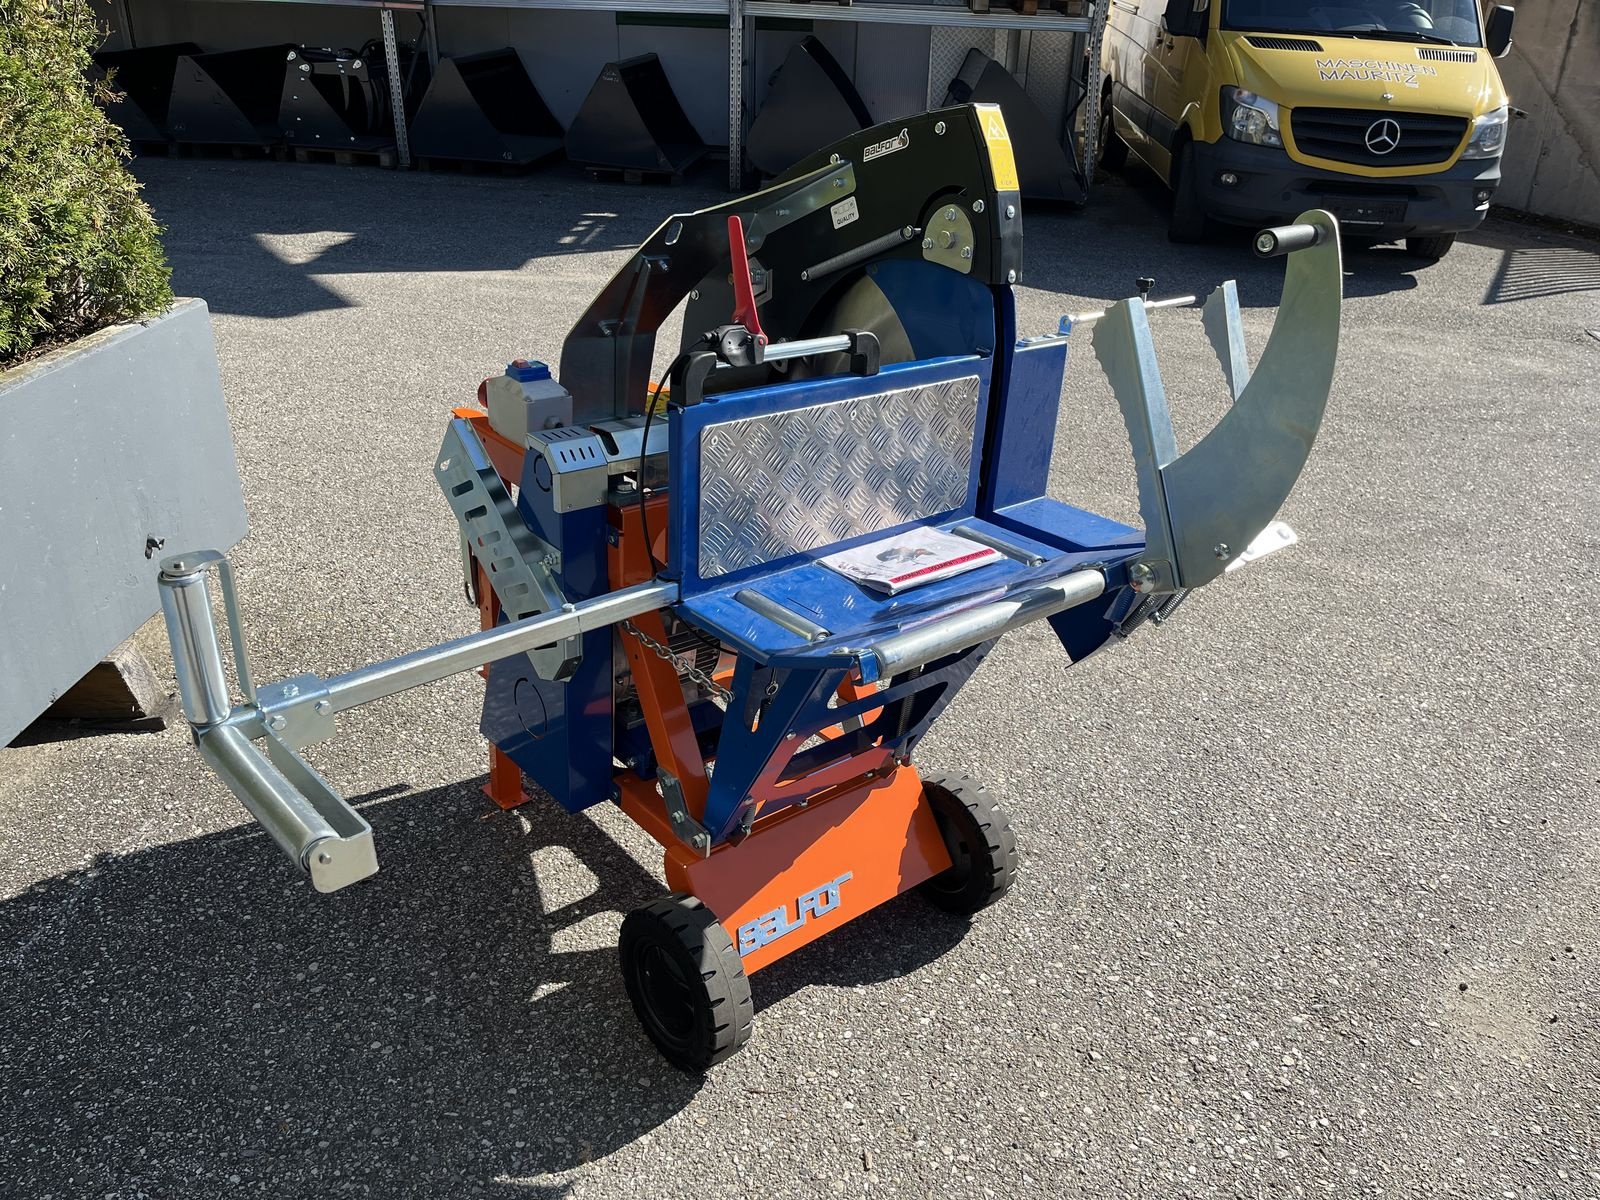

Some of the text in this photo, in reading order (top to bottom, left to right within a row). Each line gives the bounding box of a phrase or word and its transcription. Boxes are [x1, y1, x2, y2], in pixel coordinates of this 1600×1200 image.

[1315, 59, 1437, 76] MASCHINEN
[1319, 70, 1419, 88] MAURITZ
[836, 212, 855, 225] QUALITY
